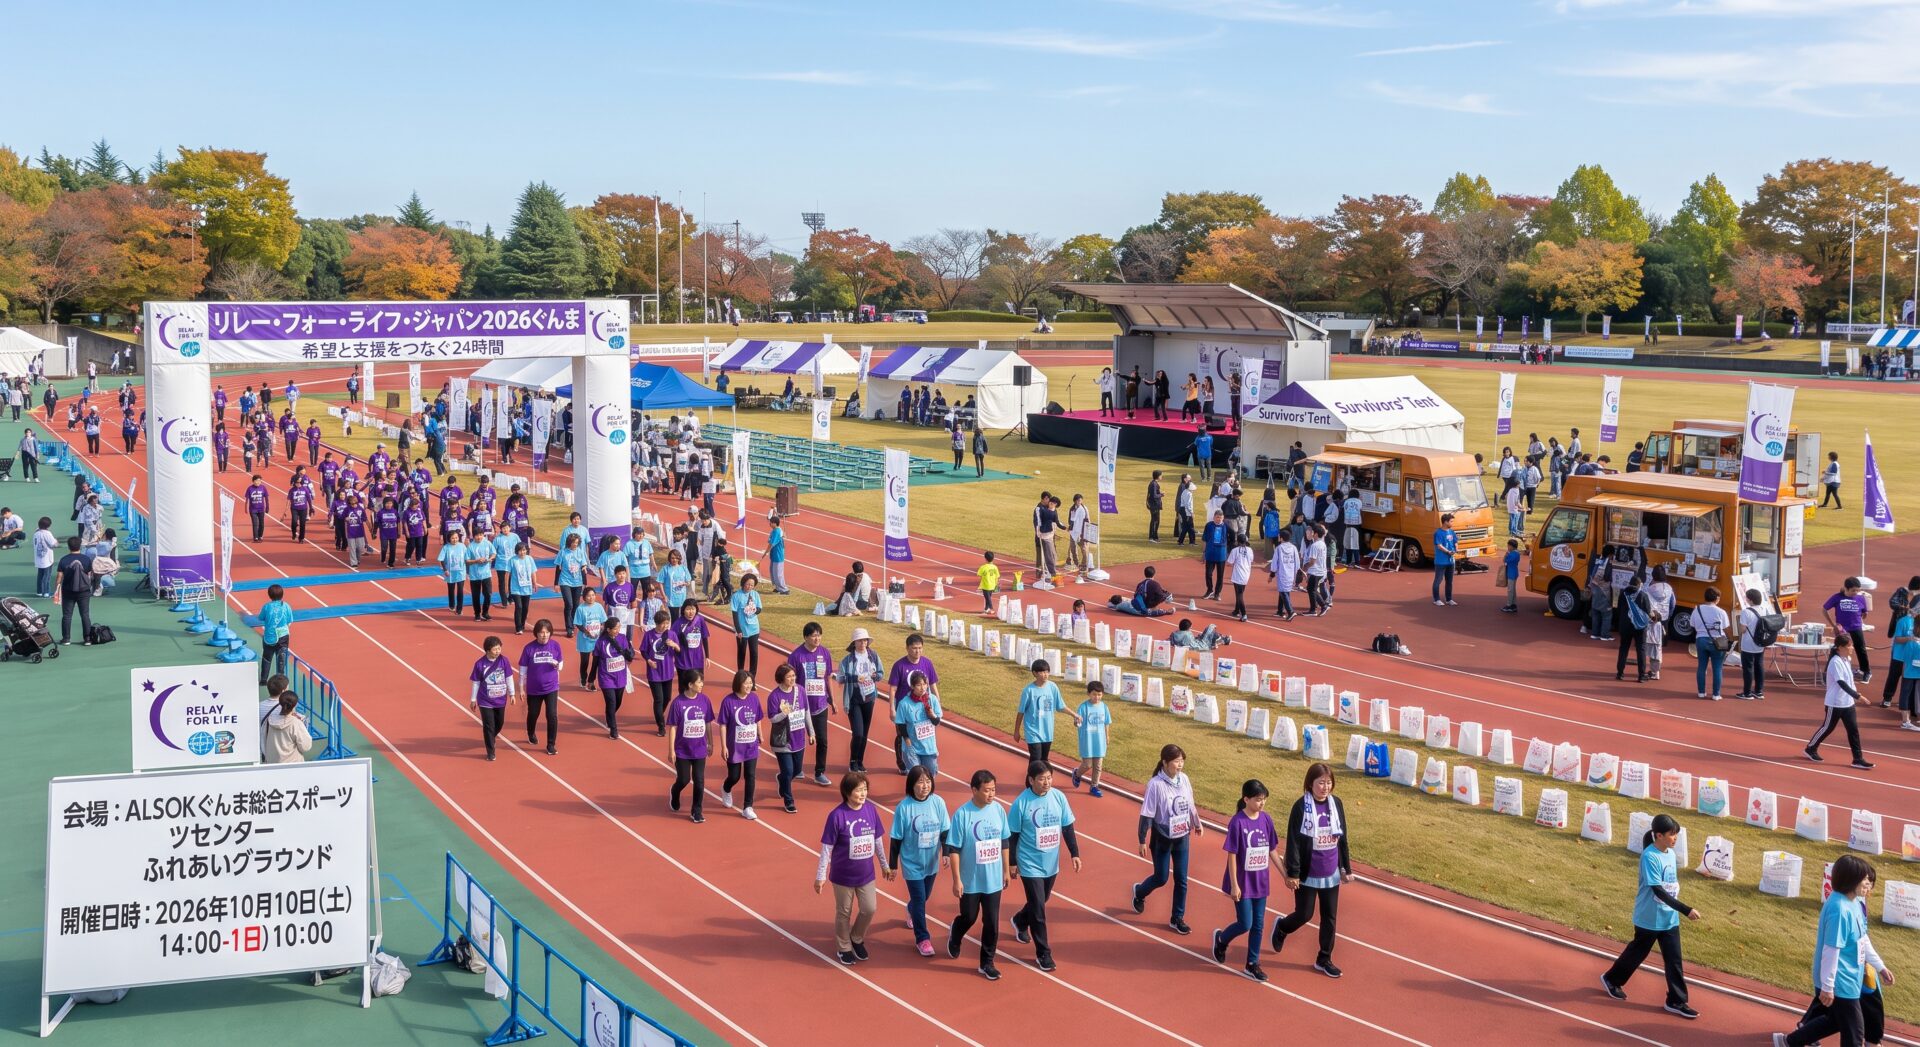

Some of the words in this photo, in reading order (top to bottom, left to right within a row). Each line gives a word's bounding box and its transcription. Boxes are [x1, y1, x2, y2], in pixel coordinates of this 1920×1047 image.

[214, 308, 580, 335] リレー・フォー・ライフ・ジャパン2026ぐんま
[302, 339, 504, 359] 希望と支援をつなぐ24時間
[1403, 396, 1439, 409] Tent
[1307, 412, 1331, 425] Tent
[186, 704, 224, 716] RELAY
[186, 716, 210, 726] FOR
[213, 714, 238, 725] LIFE
[170, 820, 275, 849] ツセンター
[143, 844, 333, 882] ふれあいグラウンド
[160, 920, 333, 957] 14:00-1日)10:00
